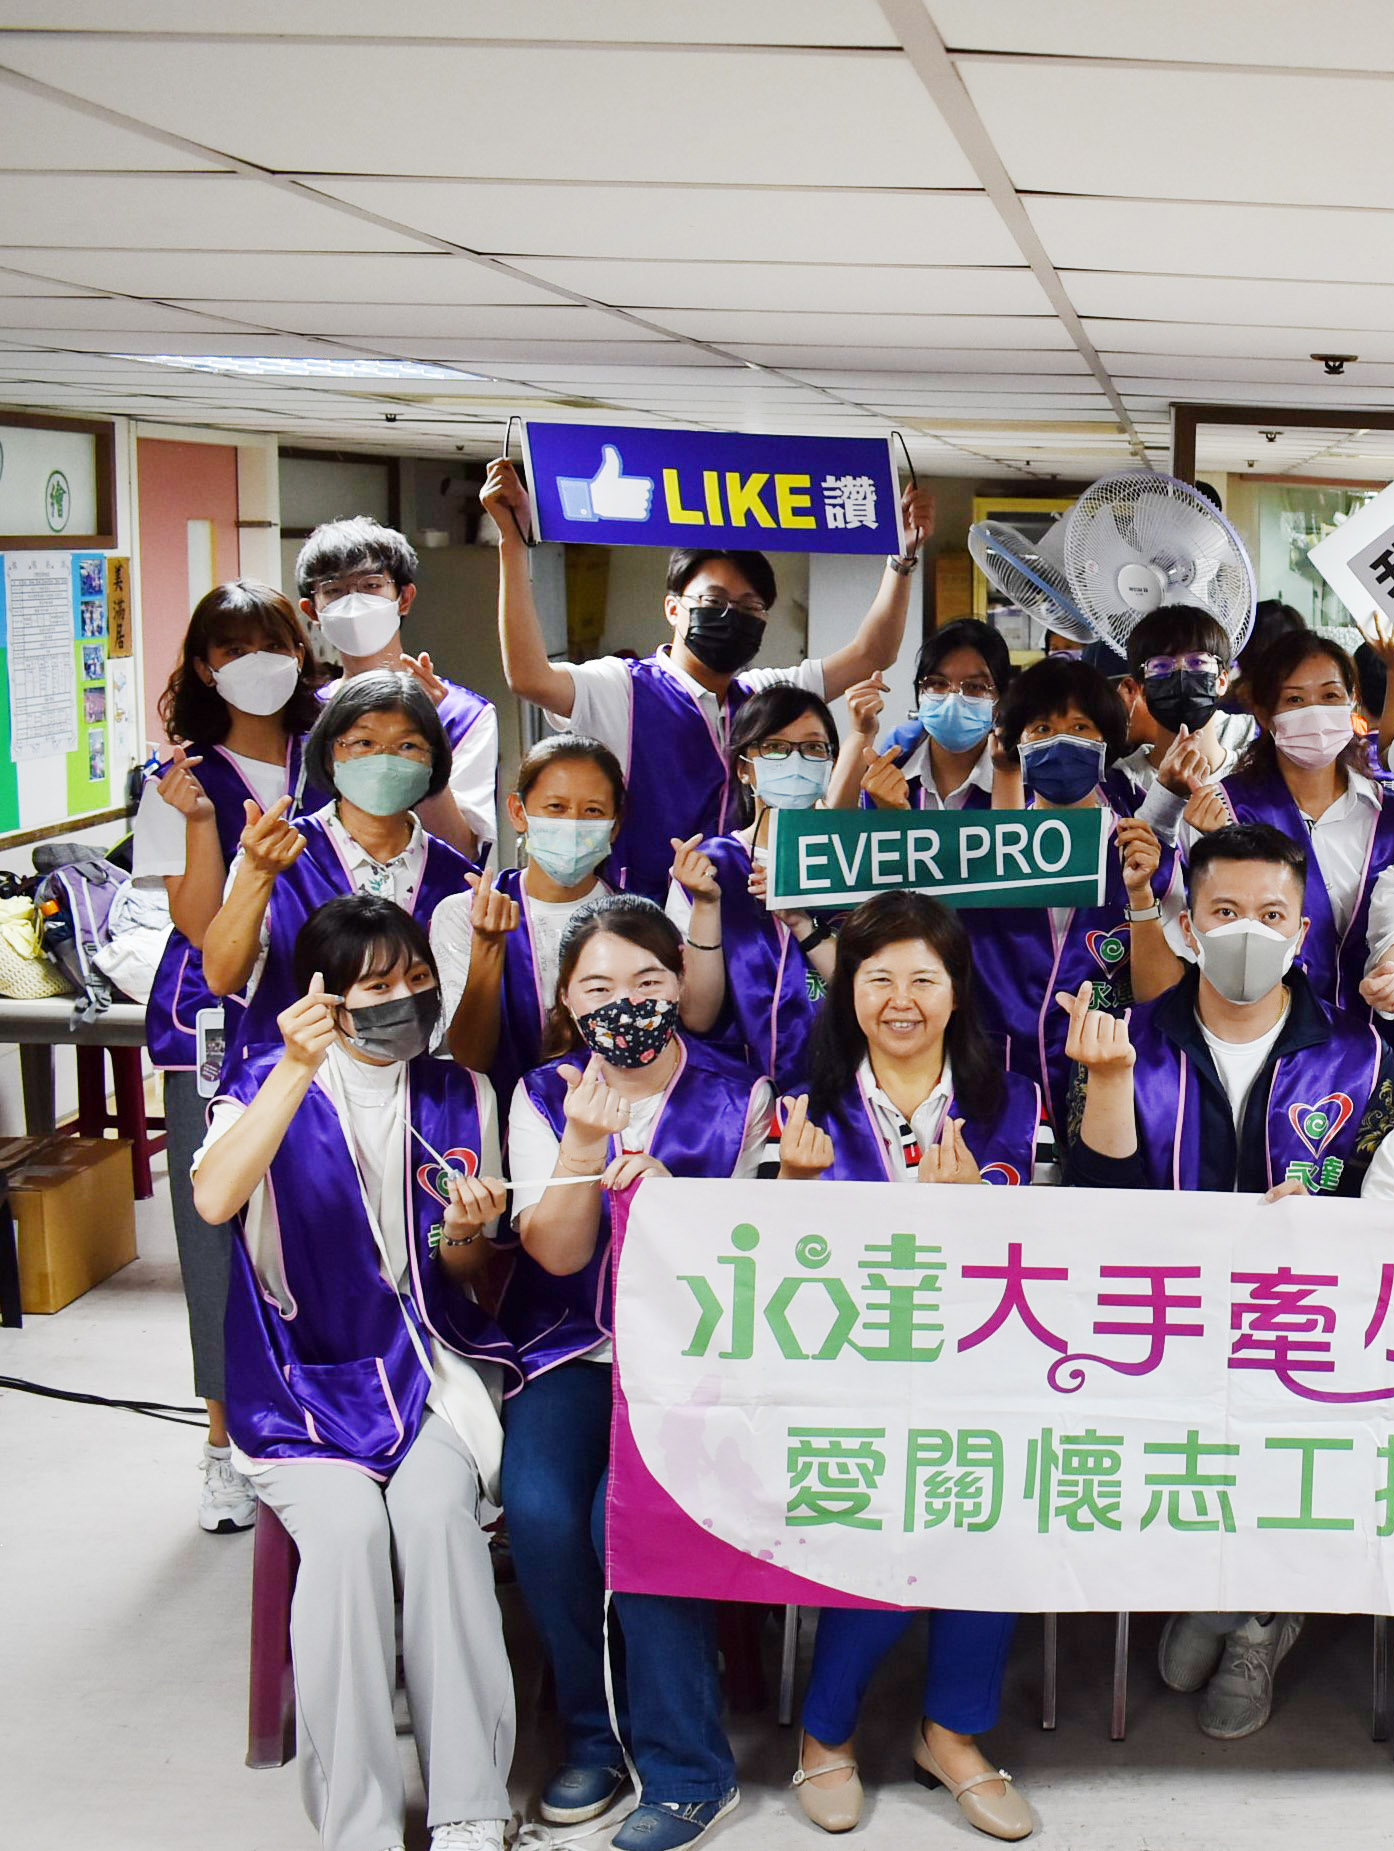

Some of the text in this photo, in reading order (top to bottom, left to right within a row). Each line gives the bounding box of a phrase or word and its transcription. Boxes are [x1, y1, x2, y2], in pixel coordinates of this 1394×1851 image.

[662, 468, 817, 529] LIKE
[821, 474, 880, 530] 讚
[798, 819, 1072, 889] EVER PRO
[1285, 1156, 1344, 1193] 永達
